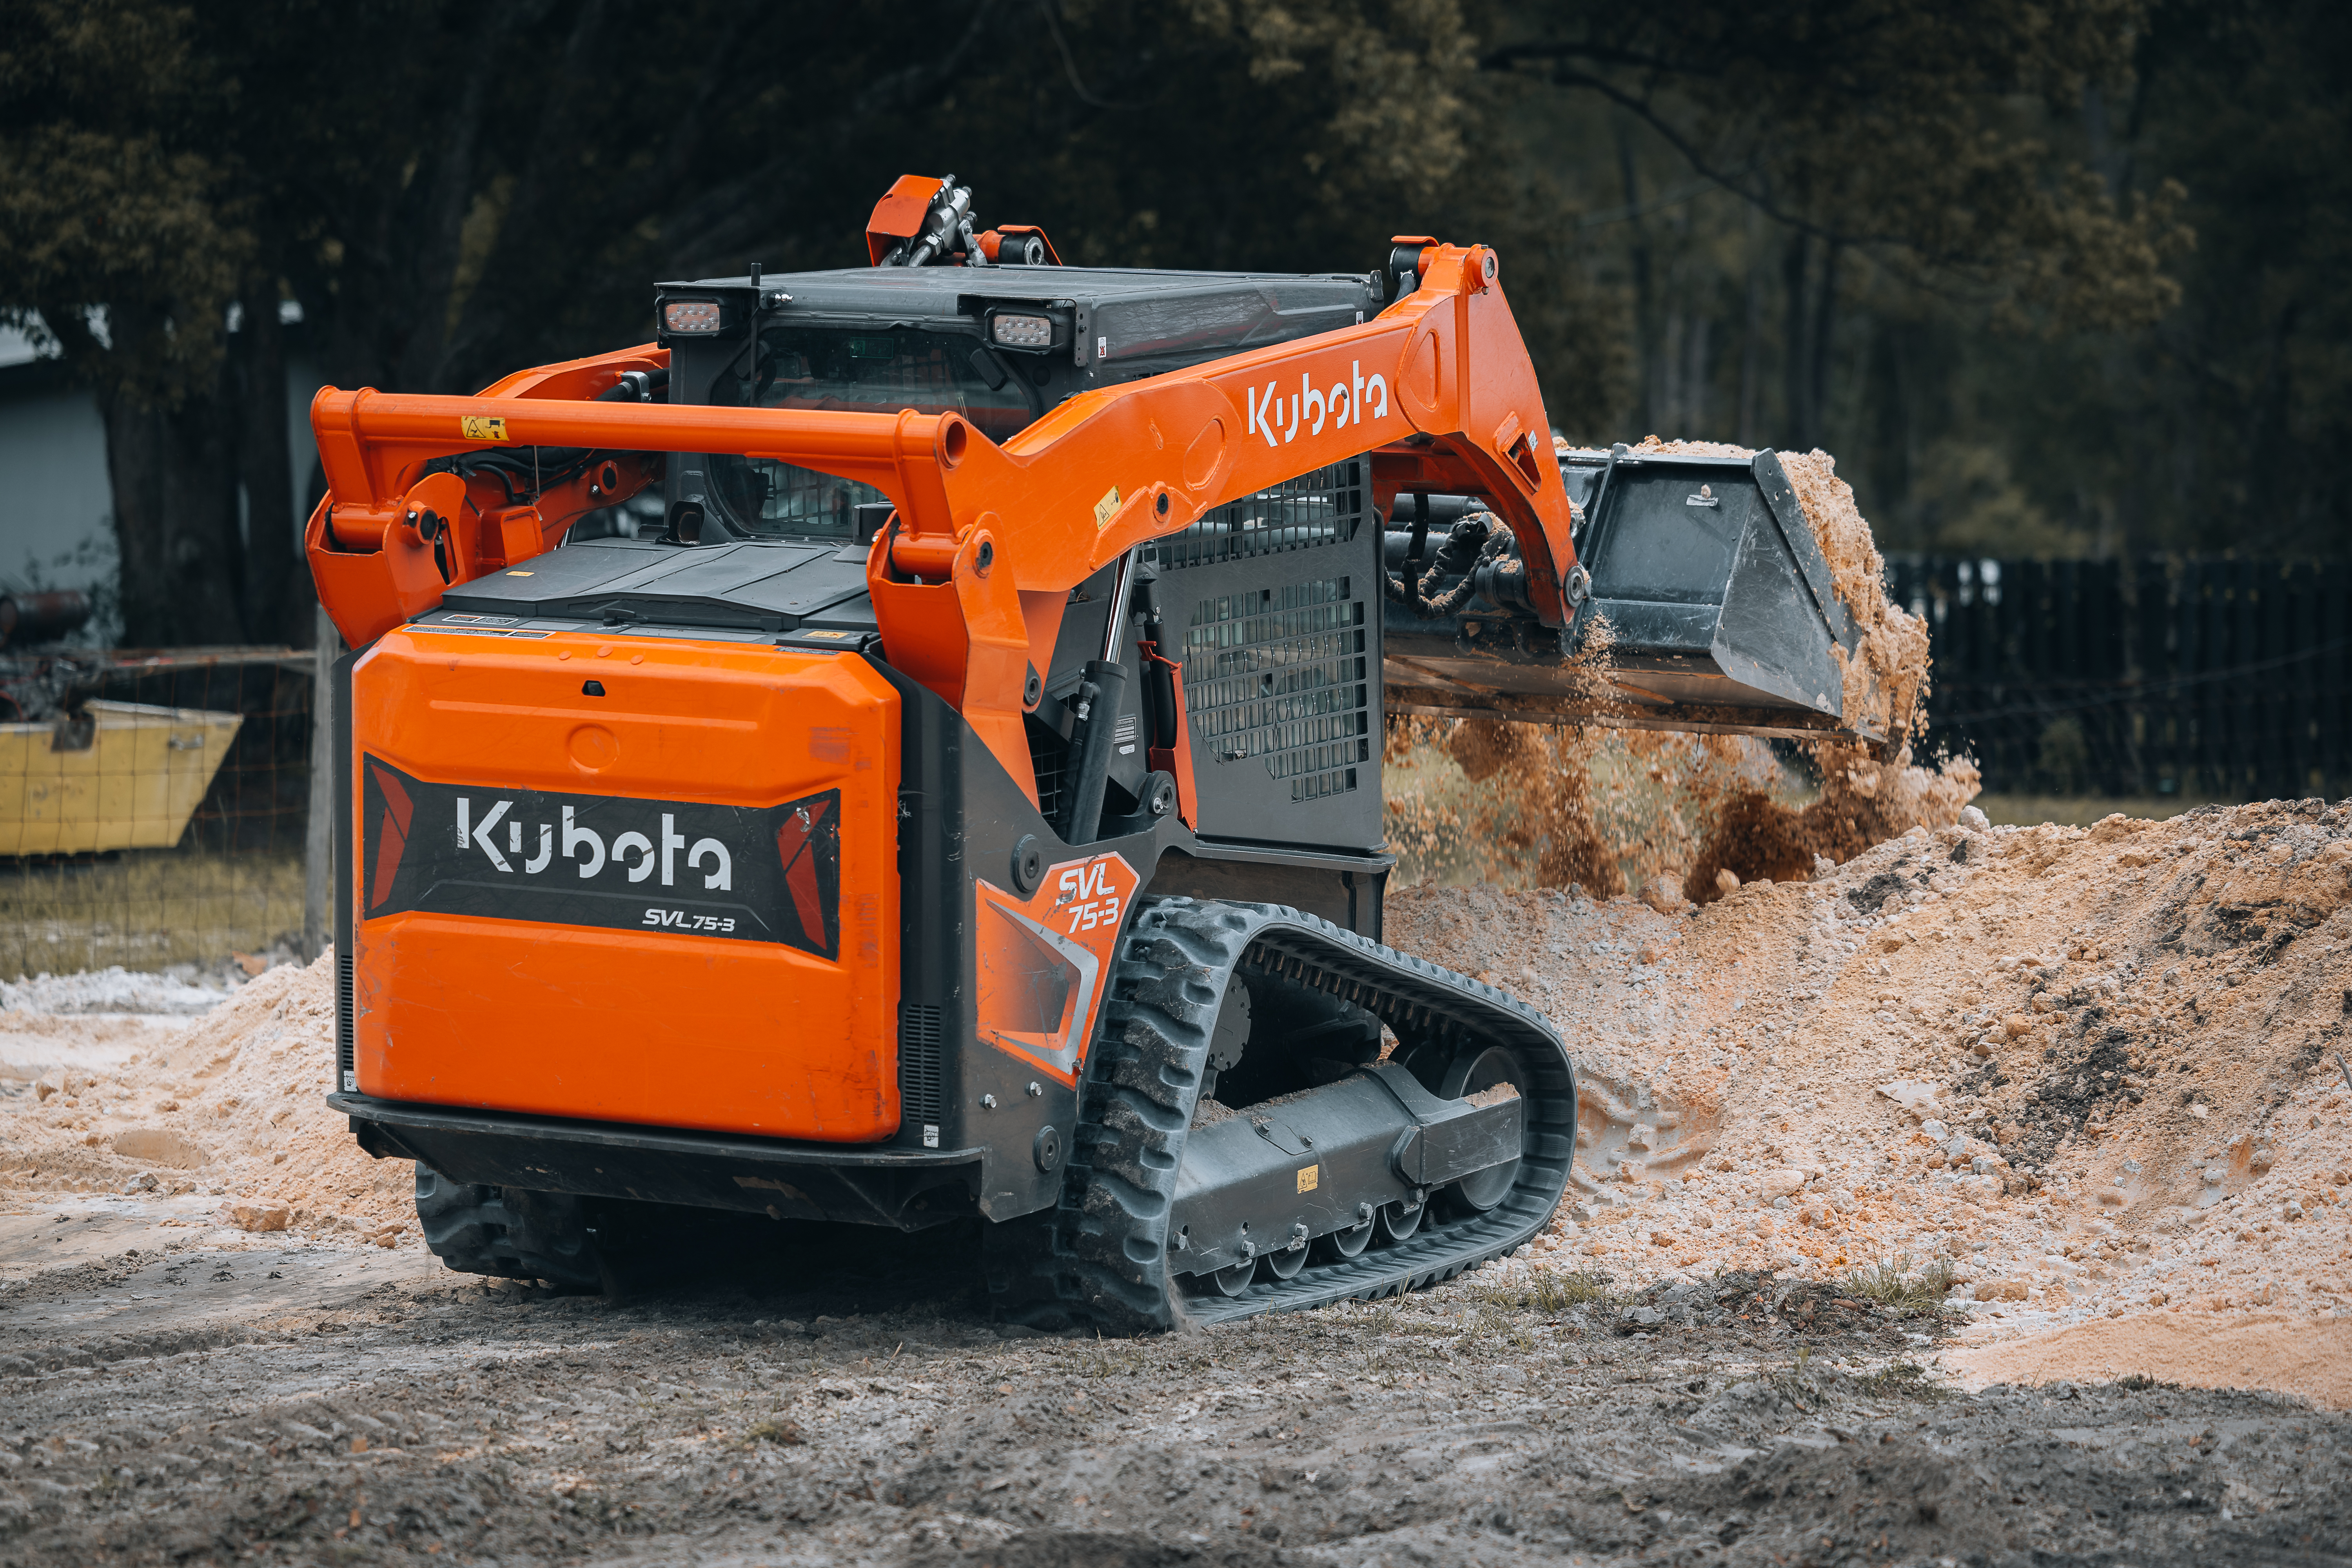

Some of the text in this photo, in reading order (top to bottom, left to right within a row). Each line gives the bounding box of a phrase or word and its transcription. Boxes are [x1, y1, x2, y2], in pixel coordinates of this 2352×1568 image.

[1248, 360, 1387, 447] Kubota
[456, 798, 731, 891] Kubota
[1055, 862, 1115, 906] SVL
[1069, 897, 1119, 934] 75-3
